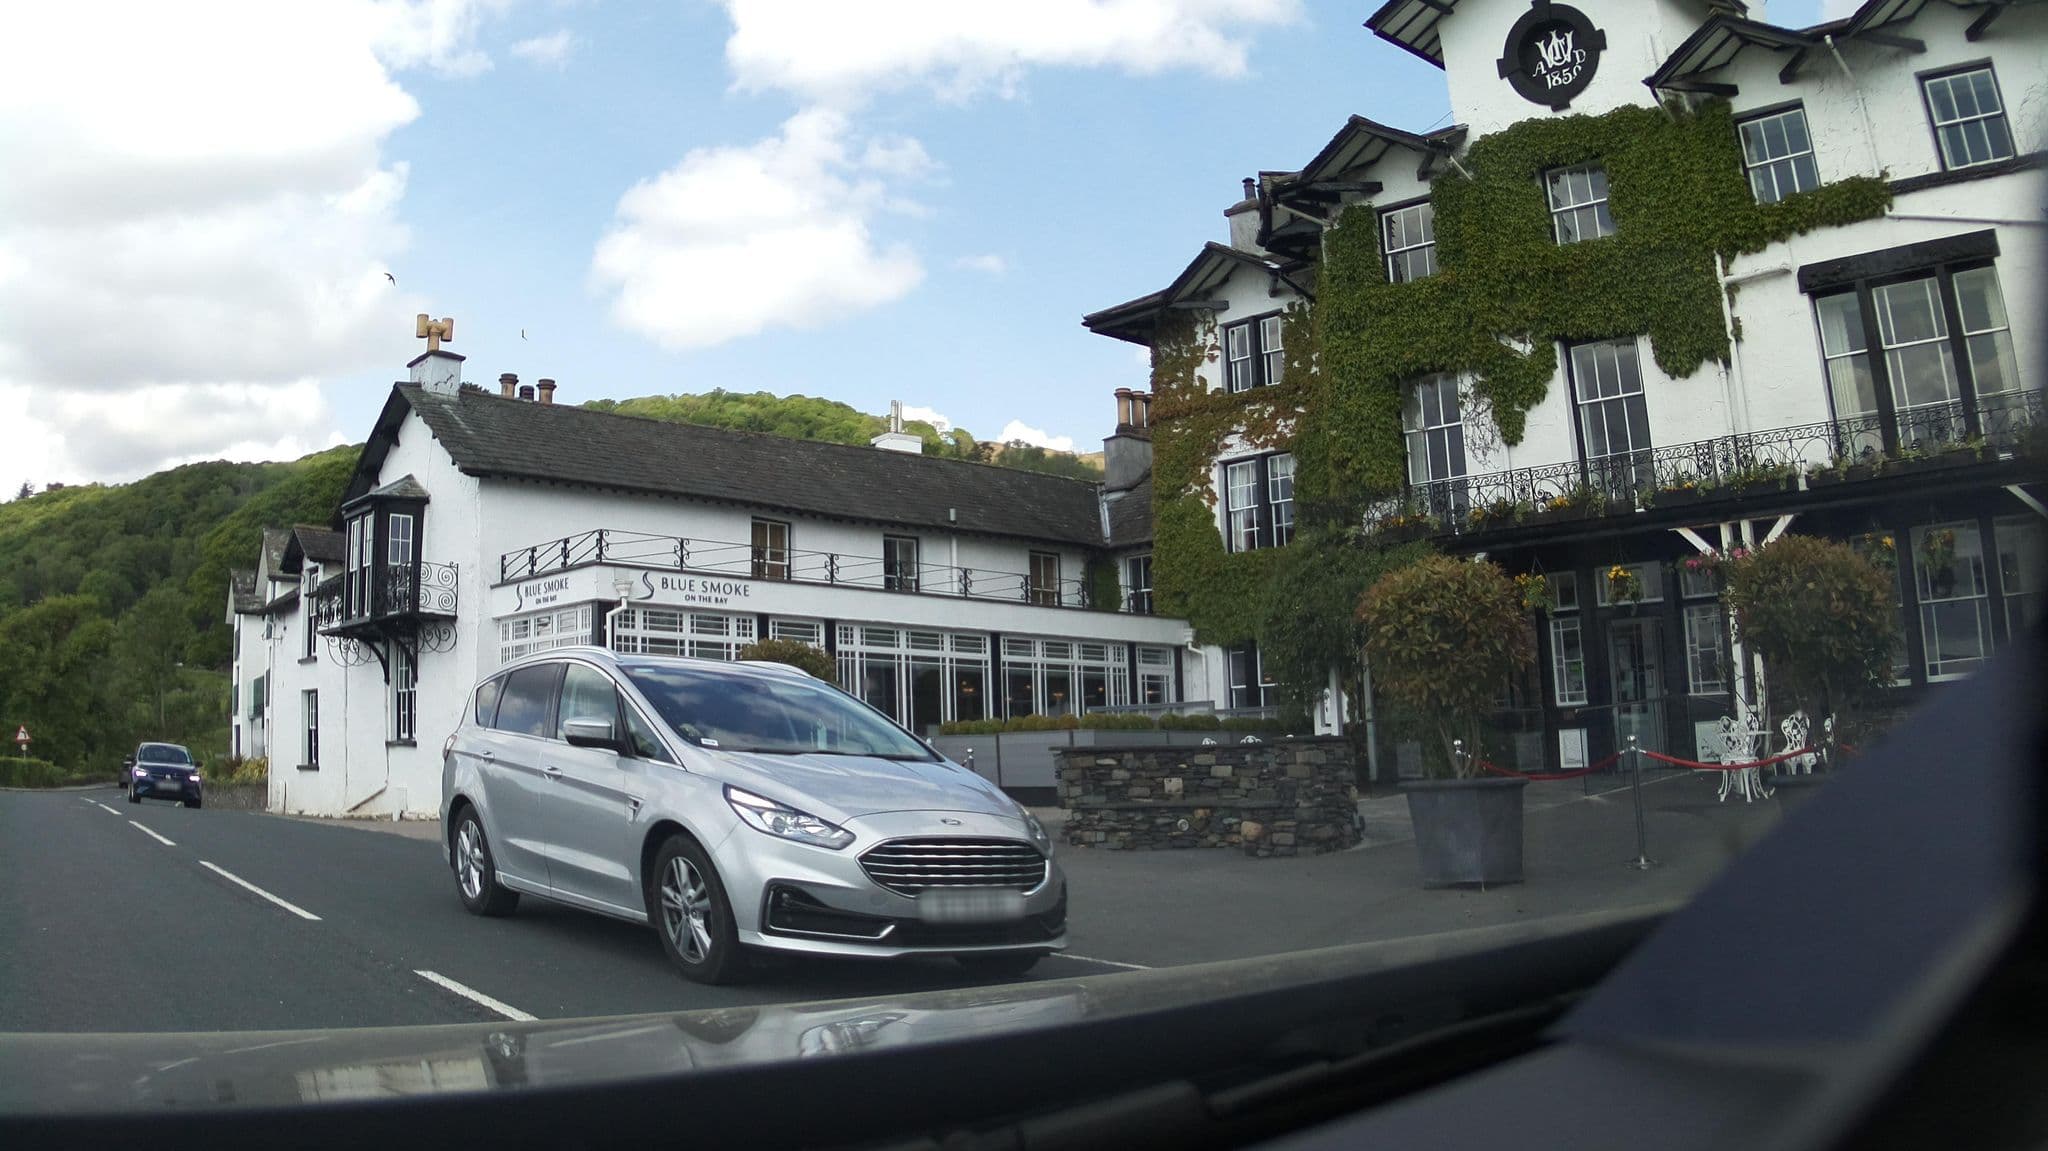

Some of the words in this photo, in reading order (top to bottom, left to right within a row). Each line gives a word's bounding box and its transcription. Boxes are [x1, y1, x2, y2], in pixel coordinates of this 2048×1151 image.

[524, 583, 541, 598] BLUE
[543, 577, 569, 594] SMOKE
[661, 576, 695, 592] BLUE
[701, 580, 750, 597] SMOKE
[684, 594, 696, 602] ON
[698, 595, 712, 603] THE
[714, 596, 728, 605] BAY
